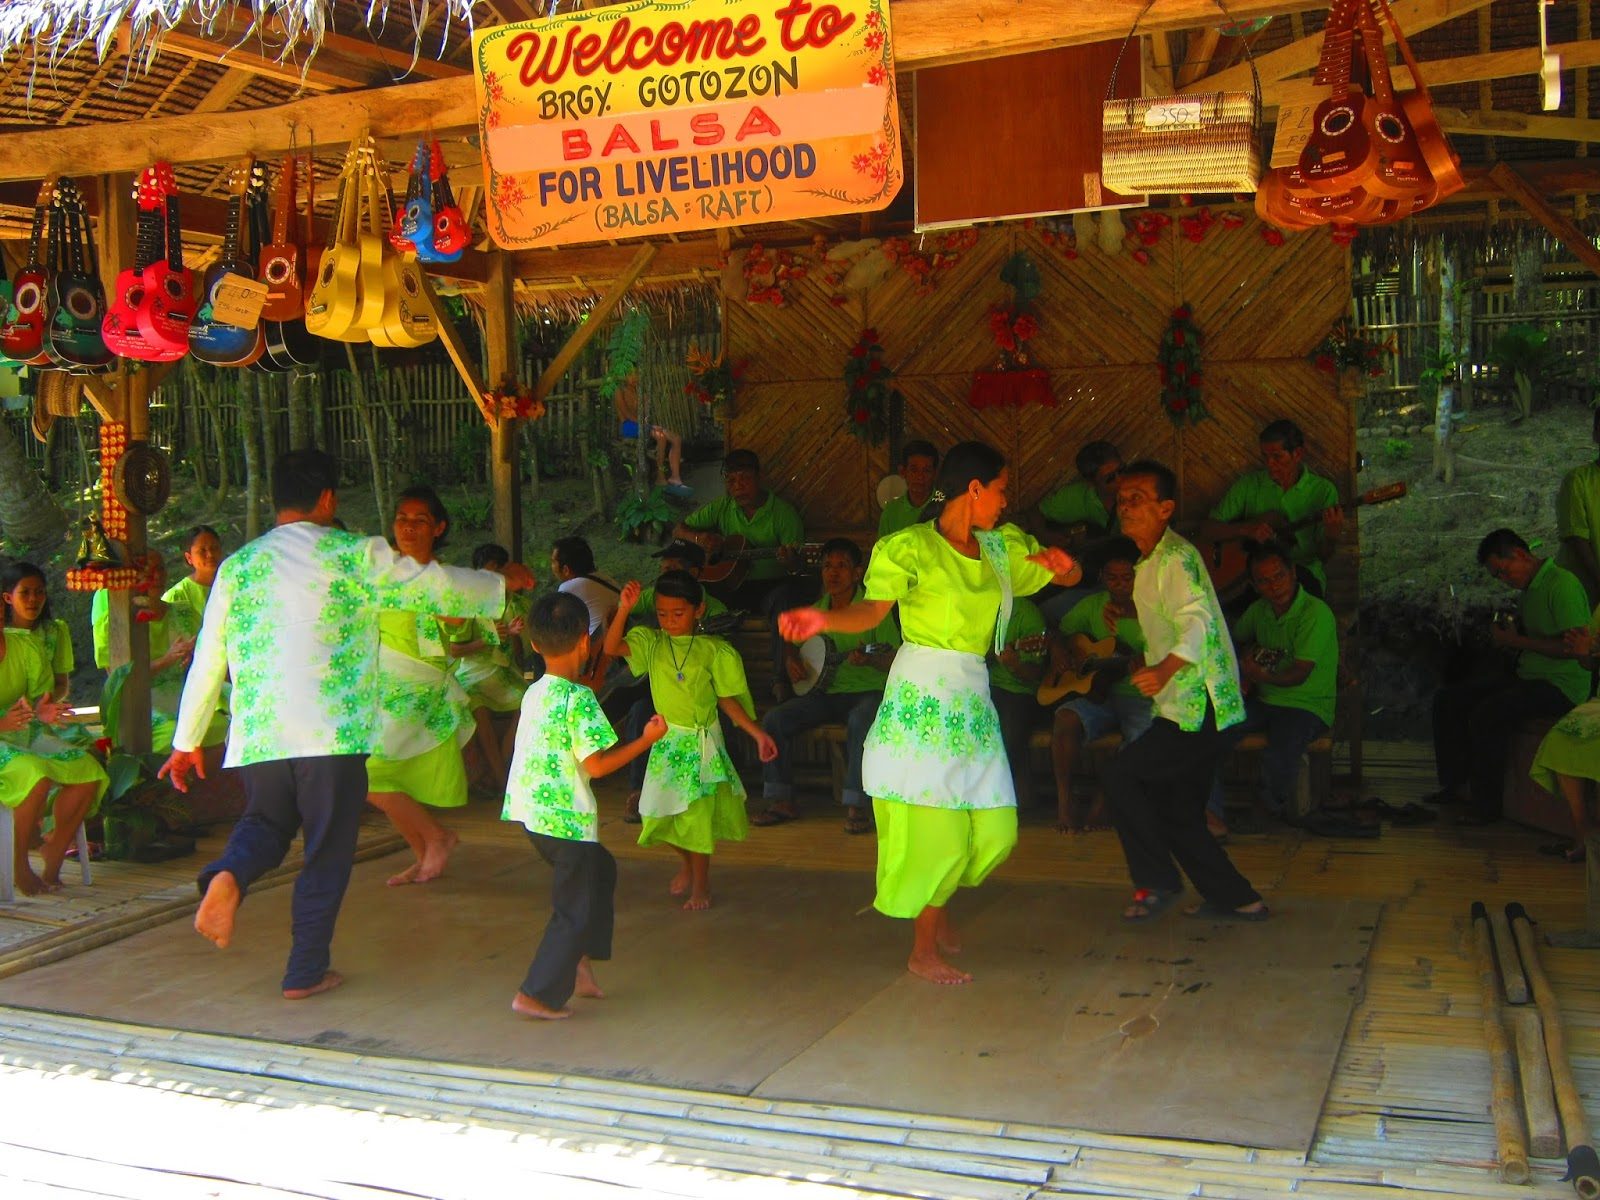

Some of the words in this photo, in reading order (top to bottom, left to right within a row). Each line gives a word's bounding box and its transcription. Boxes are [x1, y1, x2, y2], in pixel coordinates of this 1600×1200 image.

[507, 15, 768, 87] Welcome
[775, 0, 857, 52] to
[537, 81, 613, 120] BRGY.
[638, 56, 800, 108] GOTOZON
[562, 106, 782, 161] BALSA
[538, 165, 602, 208] FOR
[614, 142, 818, 198] LIVELIHOOD
